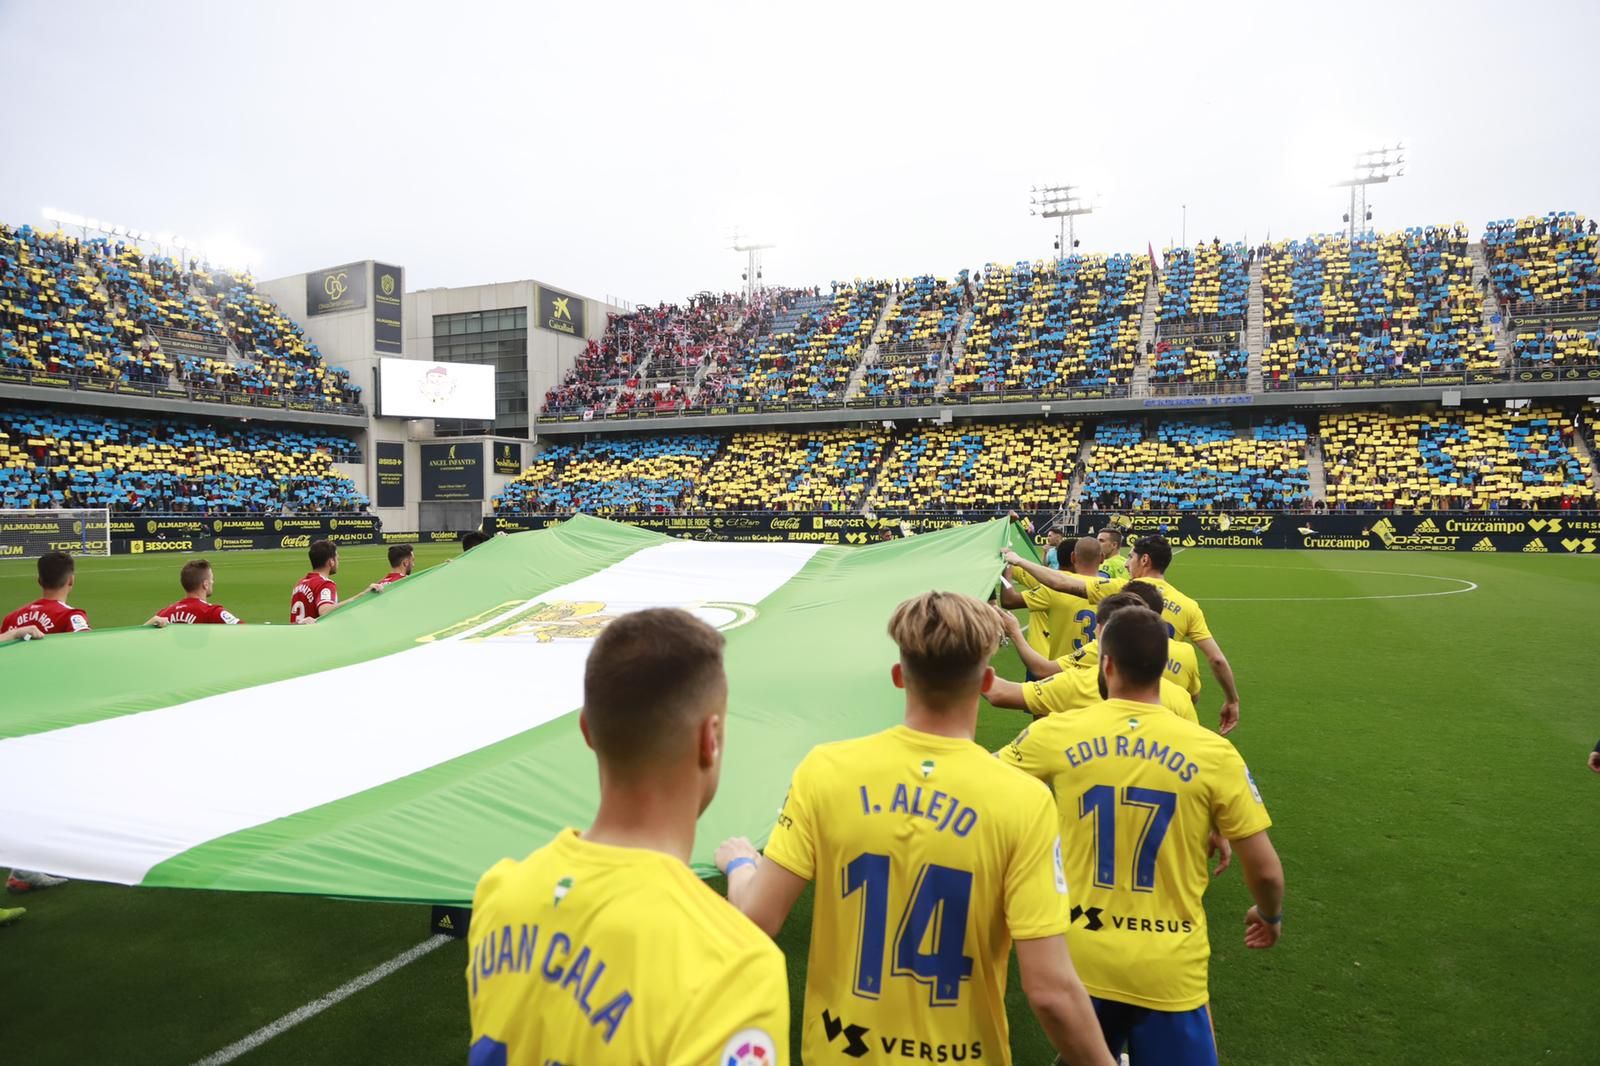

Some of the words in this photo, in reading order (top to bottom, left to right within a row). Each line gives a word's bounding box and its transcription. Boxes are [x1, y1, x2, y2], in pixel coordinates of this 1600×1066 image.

[3, 523, 60, 531] ALMADRABA
[283, 519, 321, 527] ALMADRABA
[1445, 519, 1525, 534] Cruzcampo
[1567, 521, 1600, 529] VERS
[327, 533, 373, 541] SPAGNOLO
[788, 532, 840, 541] EUROPEA
[1197, 535, 1263, 546] SmartBank
[1303, 536, 1370, 549] Cruzcampo
[1392, 536, 1461, 544] ORROT
[1162, 598, 1182, 616] GER
[168, 611, 197, 624] ALLIU
[1065, 735, 1109, 768] EDU
[1115, 735, 1199, 783] RAMOS
[859, 784, 882, 816] I.
[890, 783, 978, 838] ALEJO
[1078, 784, 1178, 893] 17
[841, 851, 975, 1008] 14
[1112, 915, 1192, 934] VERSUS
[541, 930, 634, 1046] CALA
[880, 1035, 983, 1064] VERSUS
